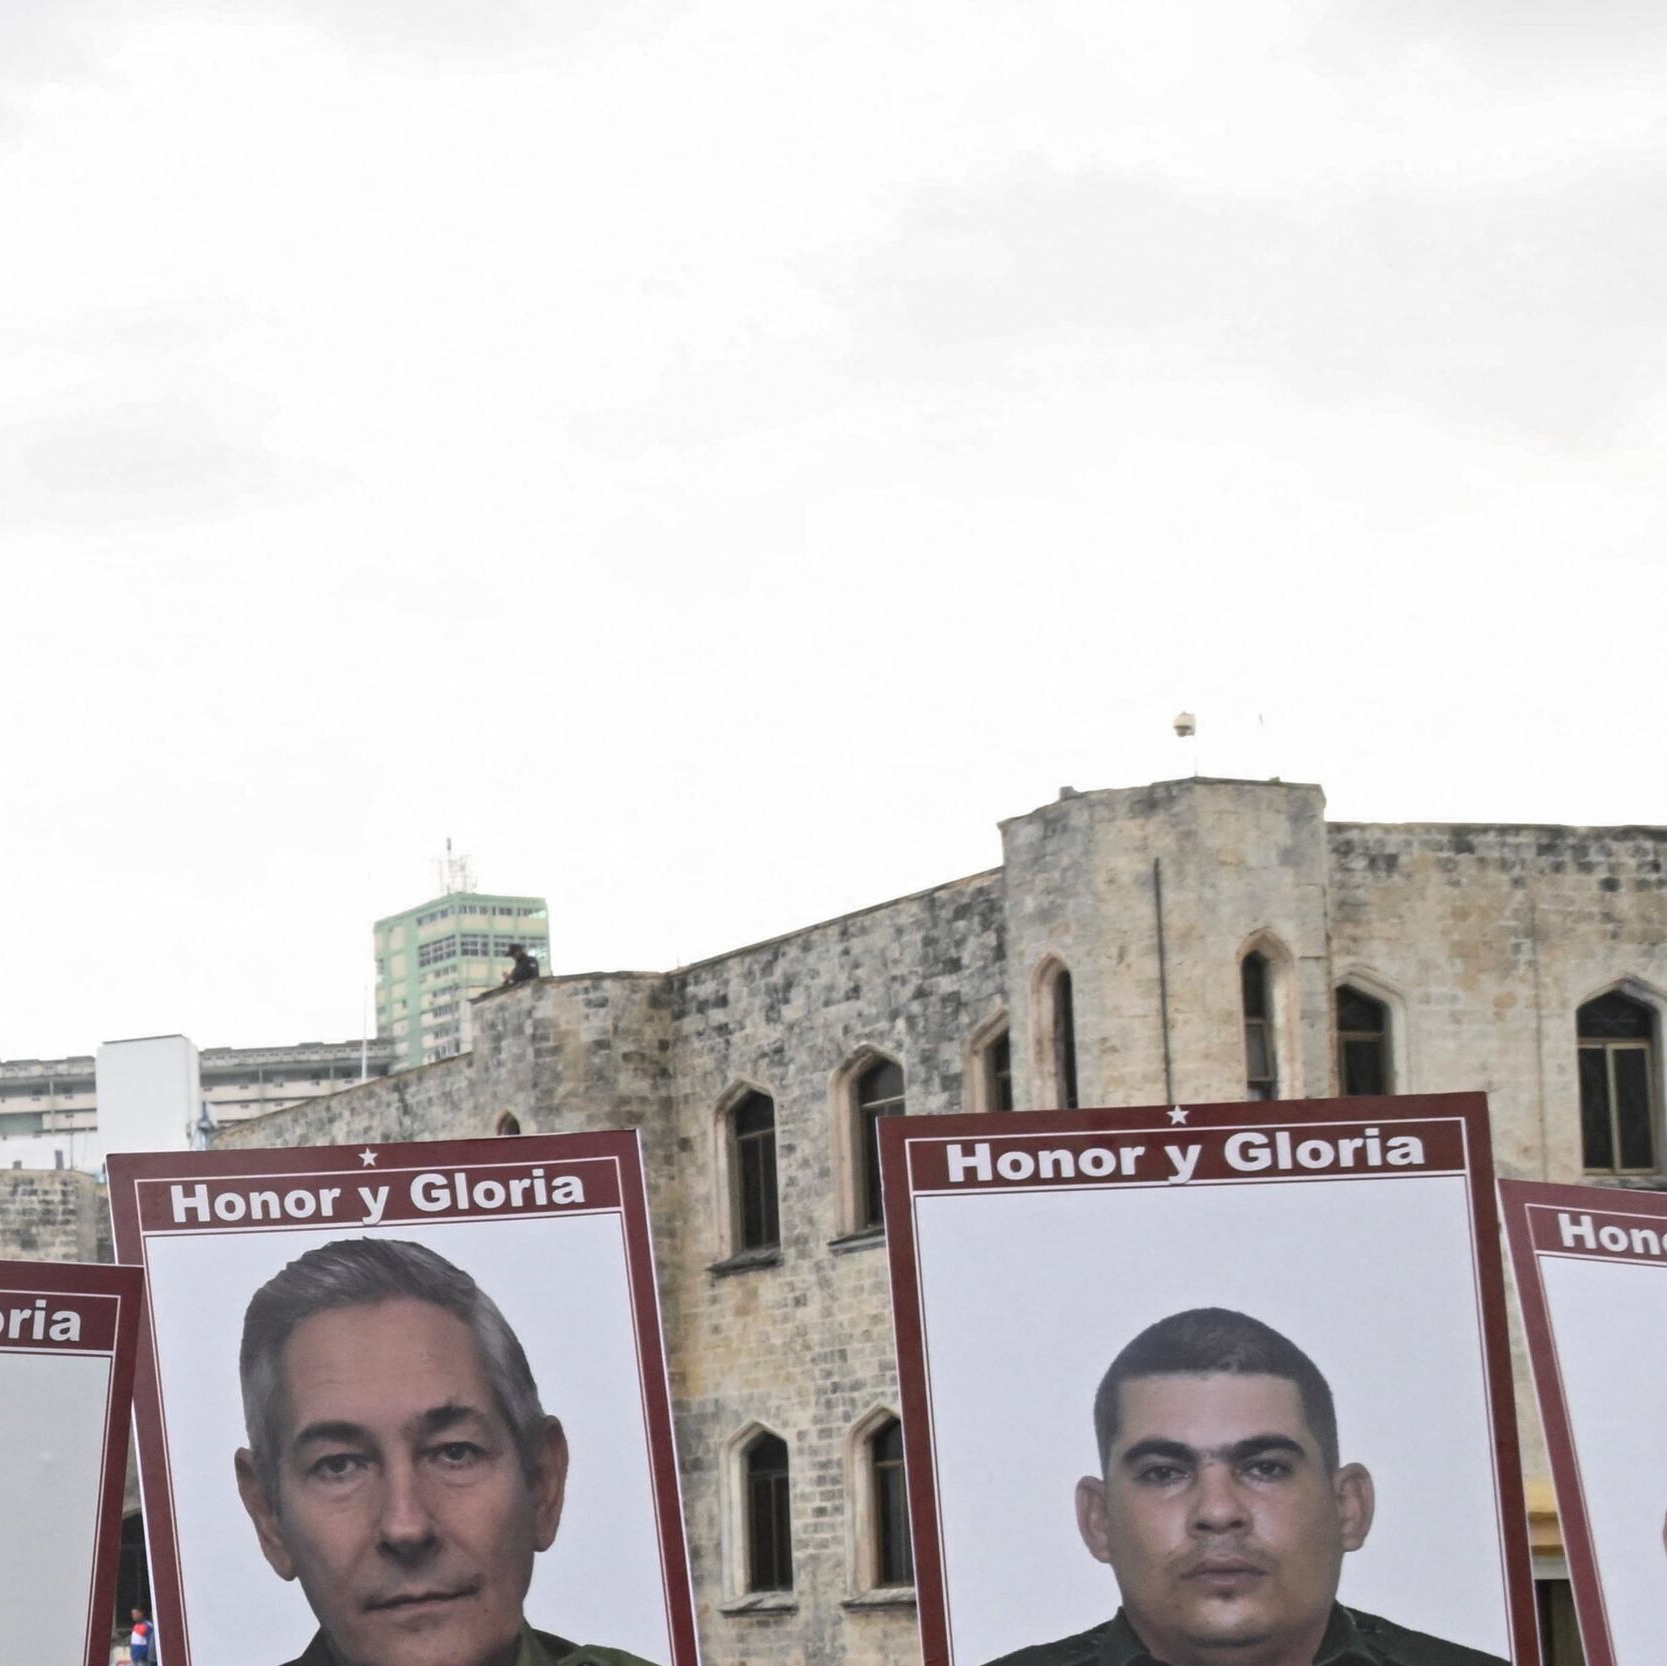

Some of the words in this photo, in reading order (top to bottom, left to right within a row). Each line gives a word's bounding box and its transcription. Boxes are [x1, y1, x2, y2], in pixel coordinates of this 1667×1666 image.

[947, 1143, 1146, 1183] Honor
[1164, 1145, 1201, 1187] y
[1225, 1128, 1425, 1172] Gloria
[171, 1183, 342, 1223] Honor
[359, 1183, 390, 1227] y
[411, 1169, 585, 1212] Gloria
[1558, 1212, 1667, 1256] Hon
